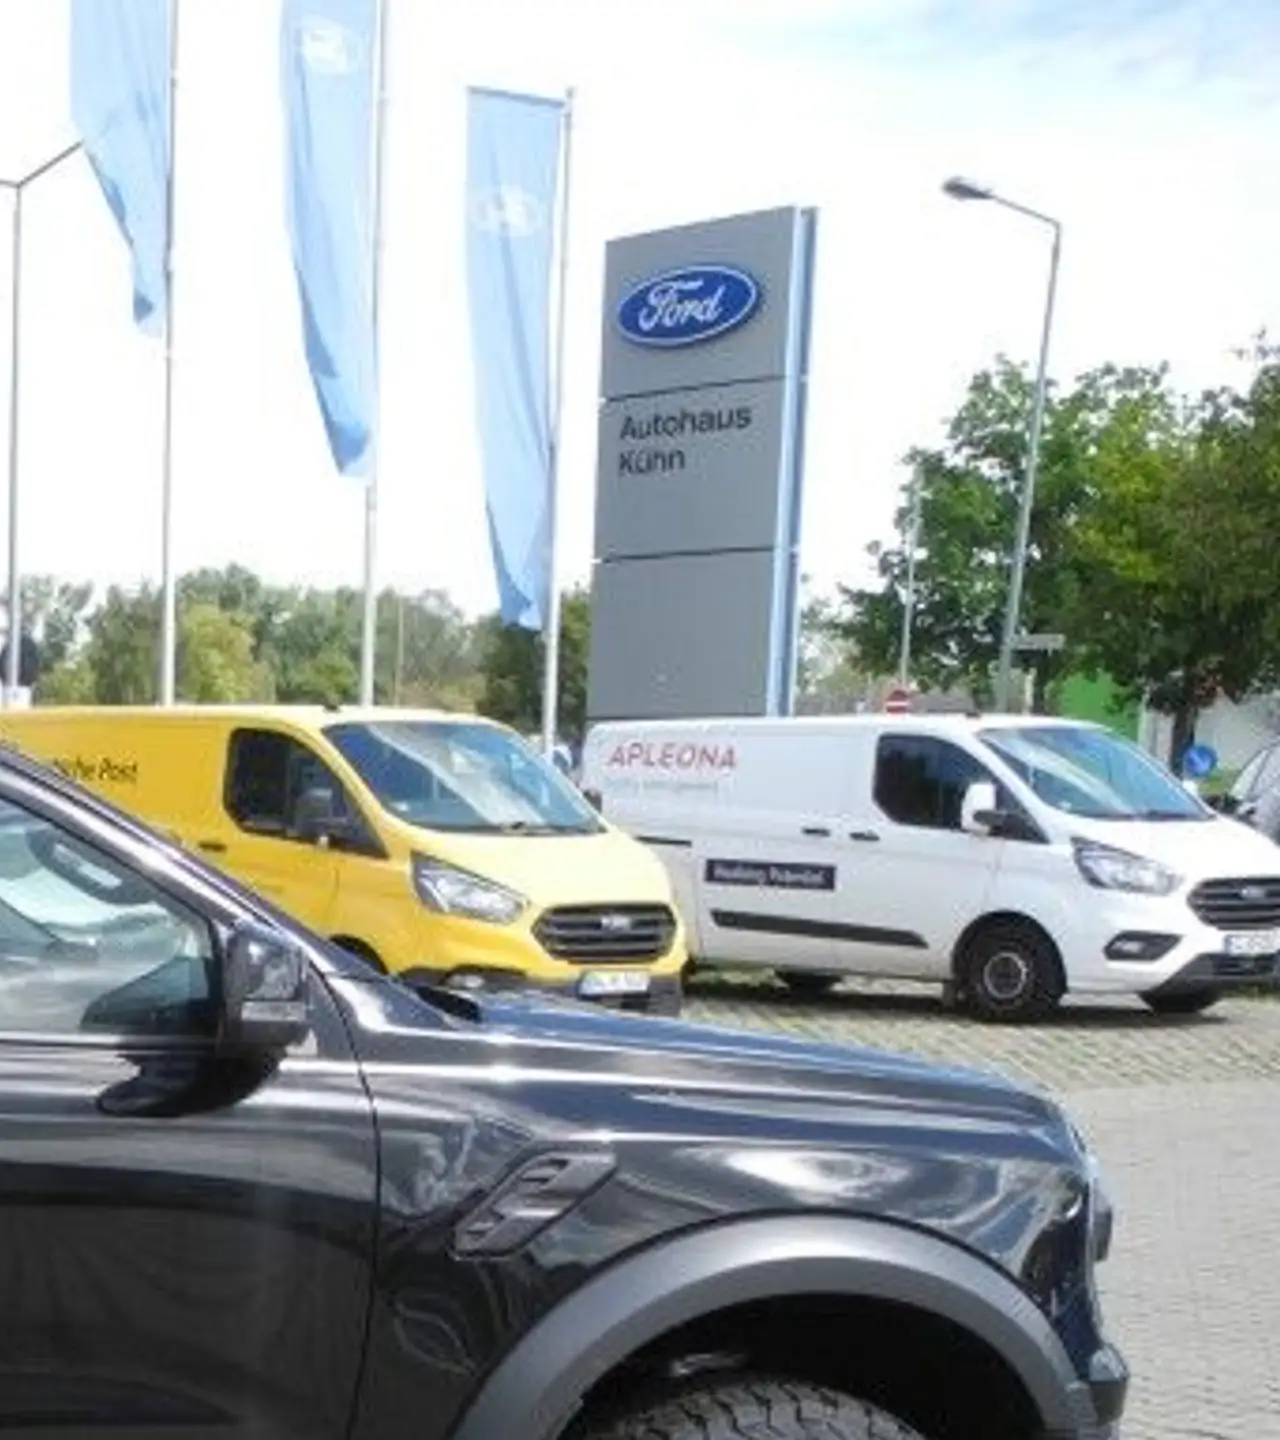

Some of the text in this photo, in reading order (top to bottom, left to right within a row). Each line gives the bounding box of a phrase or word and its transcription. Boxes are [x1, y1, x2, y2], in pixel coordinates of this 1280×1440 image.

[638, 278, 726, 332] Ford
[619, 406, 753, 441] Autohaus
[99, 757, 139, 784] Post
[606, 740, 738, 770] APLEONA
